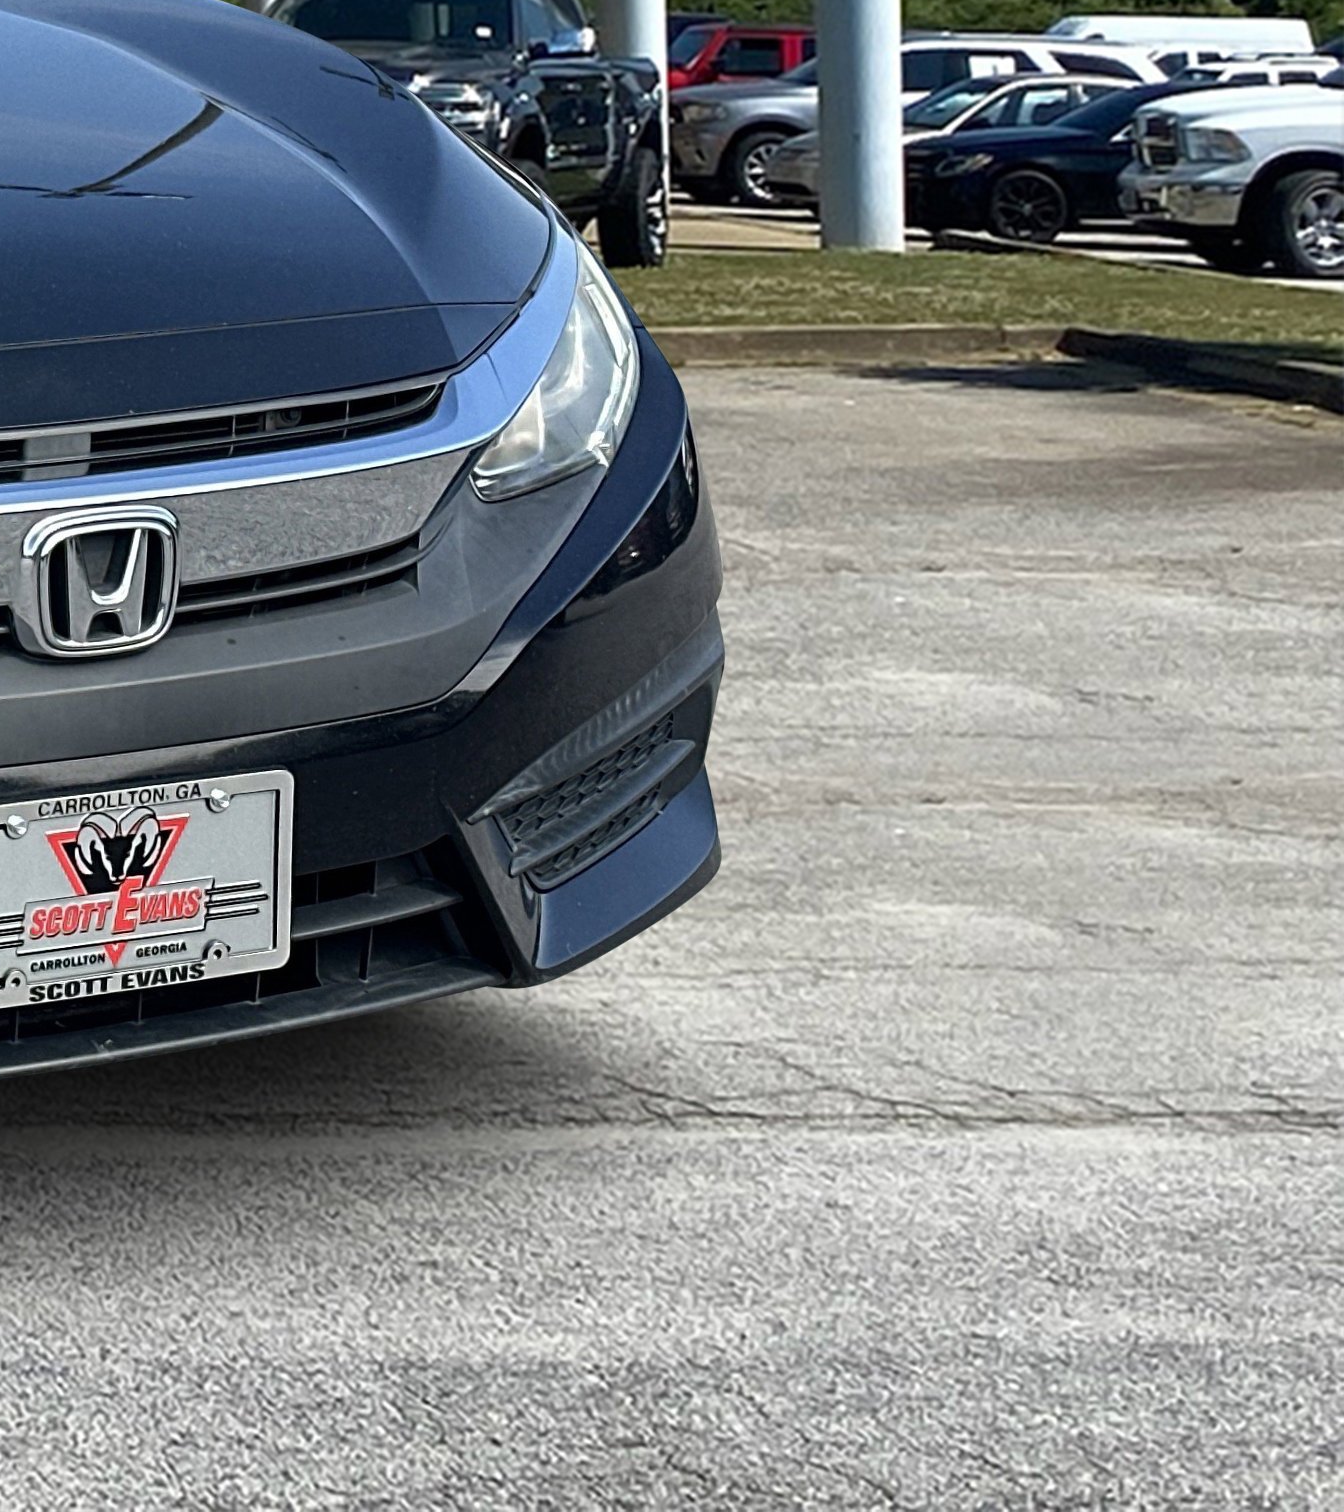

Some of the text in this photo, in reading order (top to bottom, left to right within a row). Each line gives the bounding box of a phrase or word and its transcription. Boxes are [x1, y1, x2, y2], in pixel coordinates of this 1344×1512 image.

[175, 782, 202, 799] GA
[29, 874, 203, 939] SCOTT EVANS
[30, 941, 188, 973] CARROLLTON GEORGIA
[28, 962, 205, 1003] SCOTT EVANS
